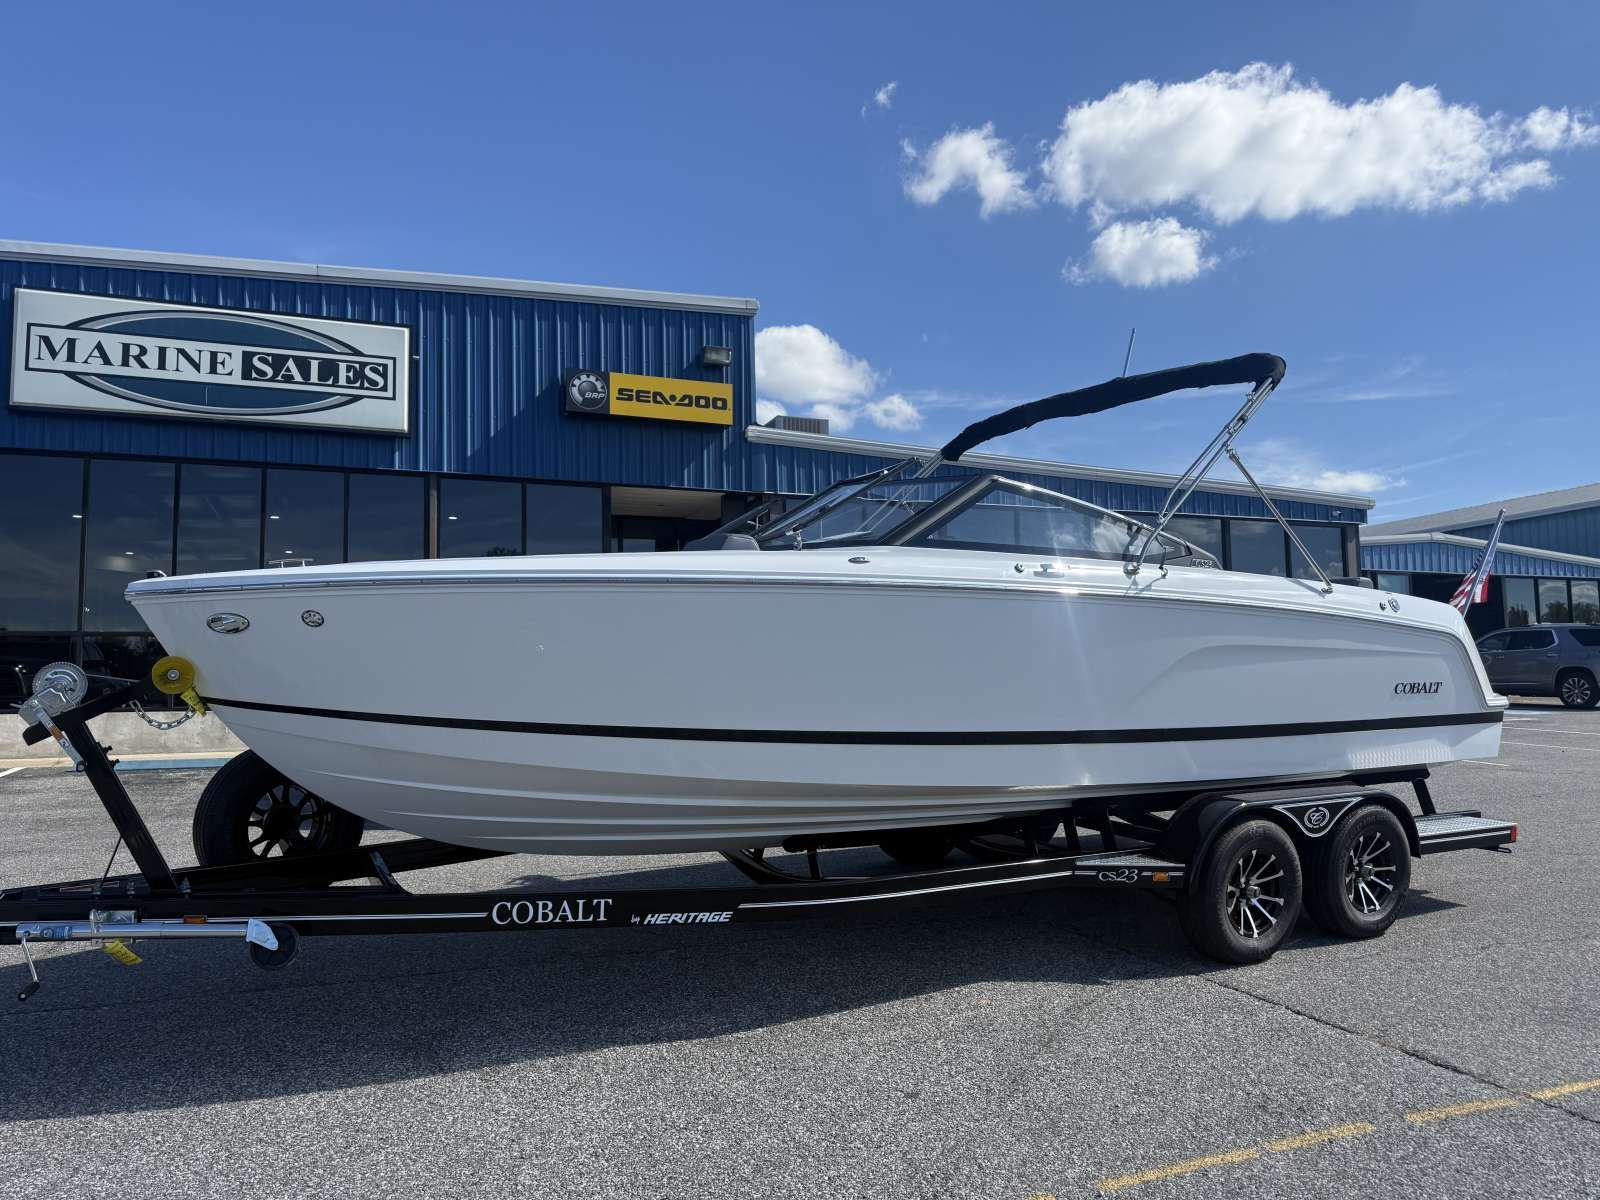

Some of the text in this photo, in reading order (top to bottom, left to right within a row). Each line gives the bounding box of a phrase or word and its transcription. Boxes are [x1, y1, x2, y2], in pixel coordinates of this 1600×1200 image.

[34, 334, 385, 390] MARINE SALES
[584, 391, 606, 400] BRP
[1394, 681, 1443, 695] COBALT
[491, 897, 613, 925] COBALT
[642, 911, 734, 926] HERITAGE
